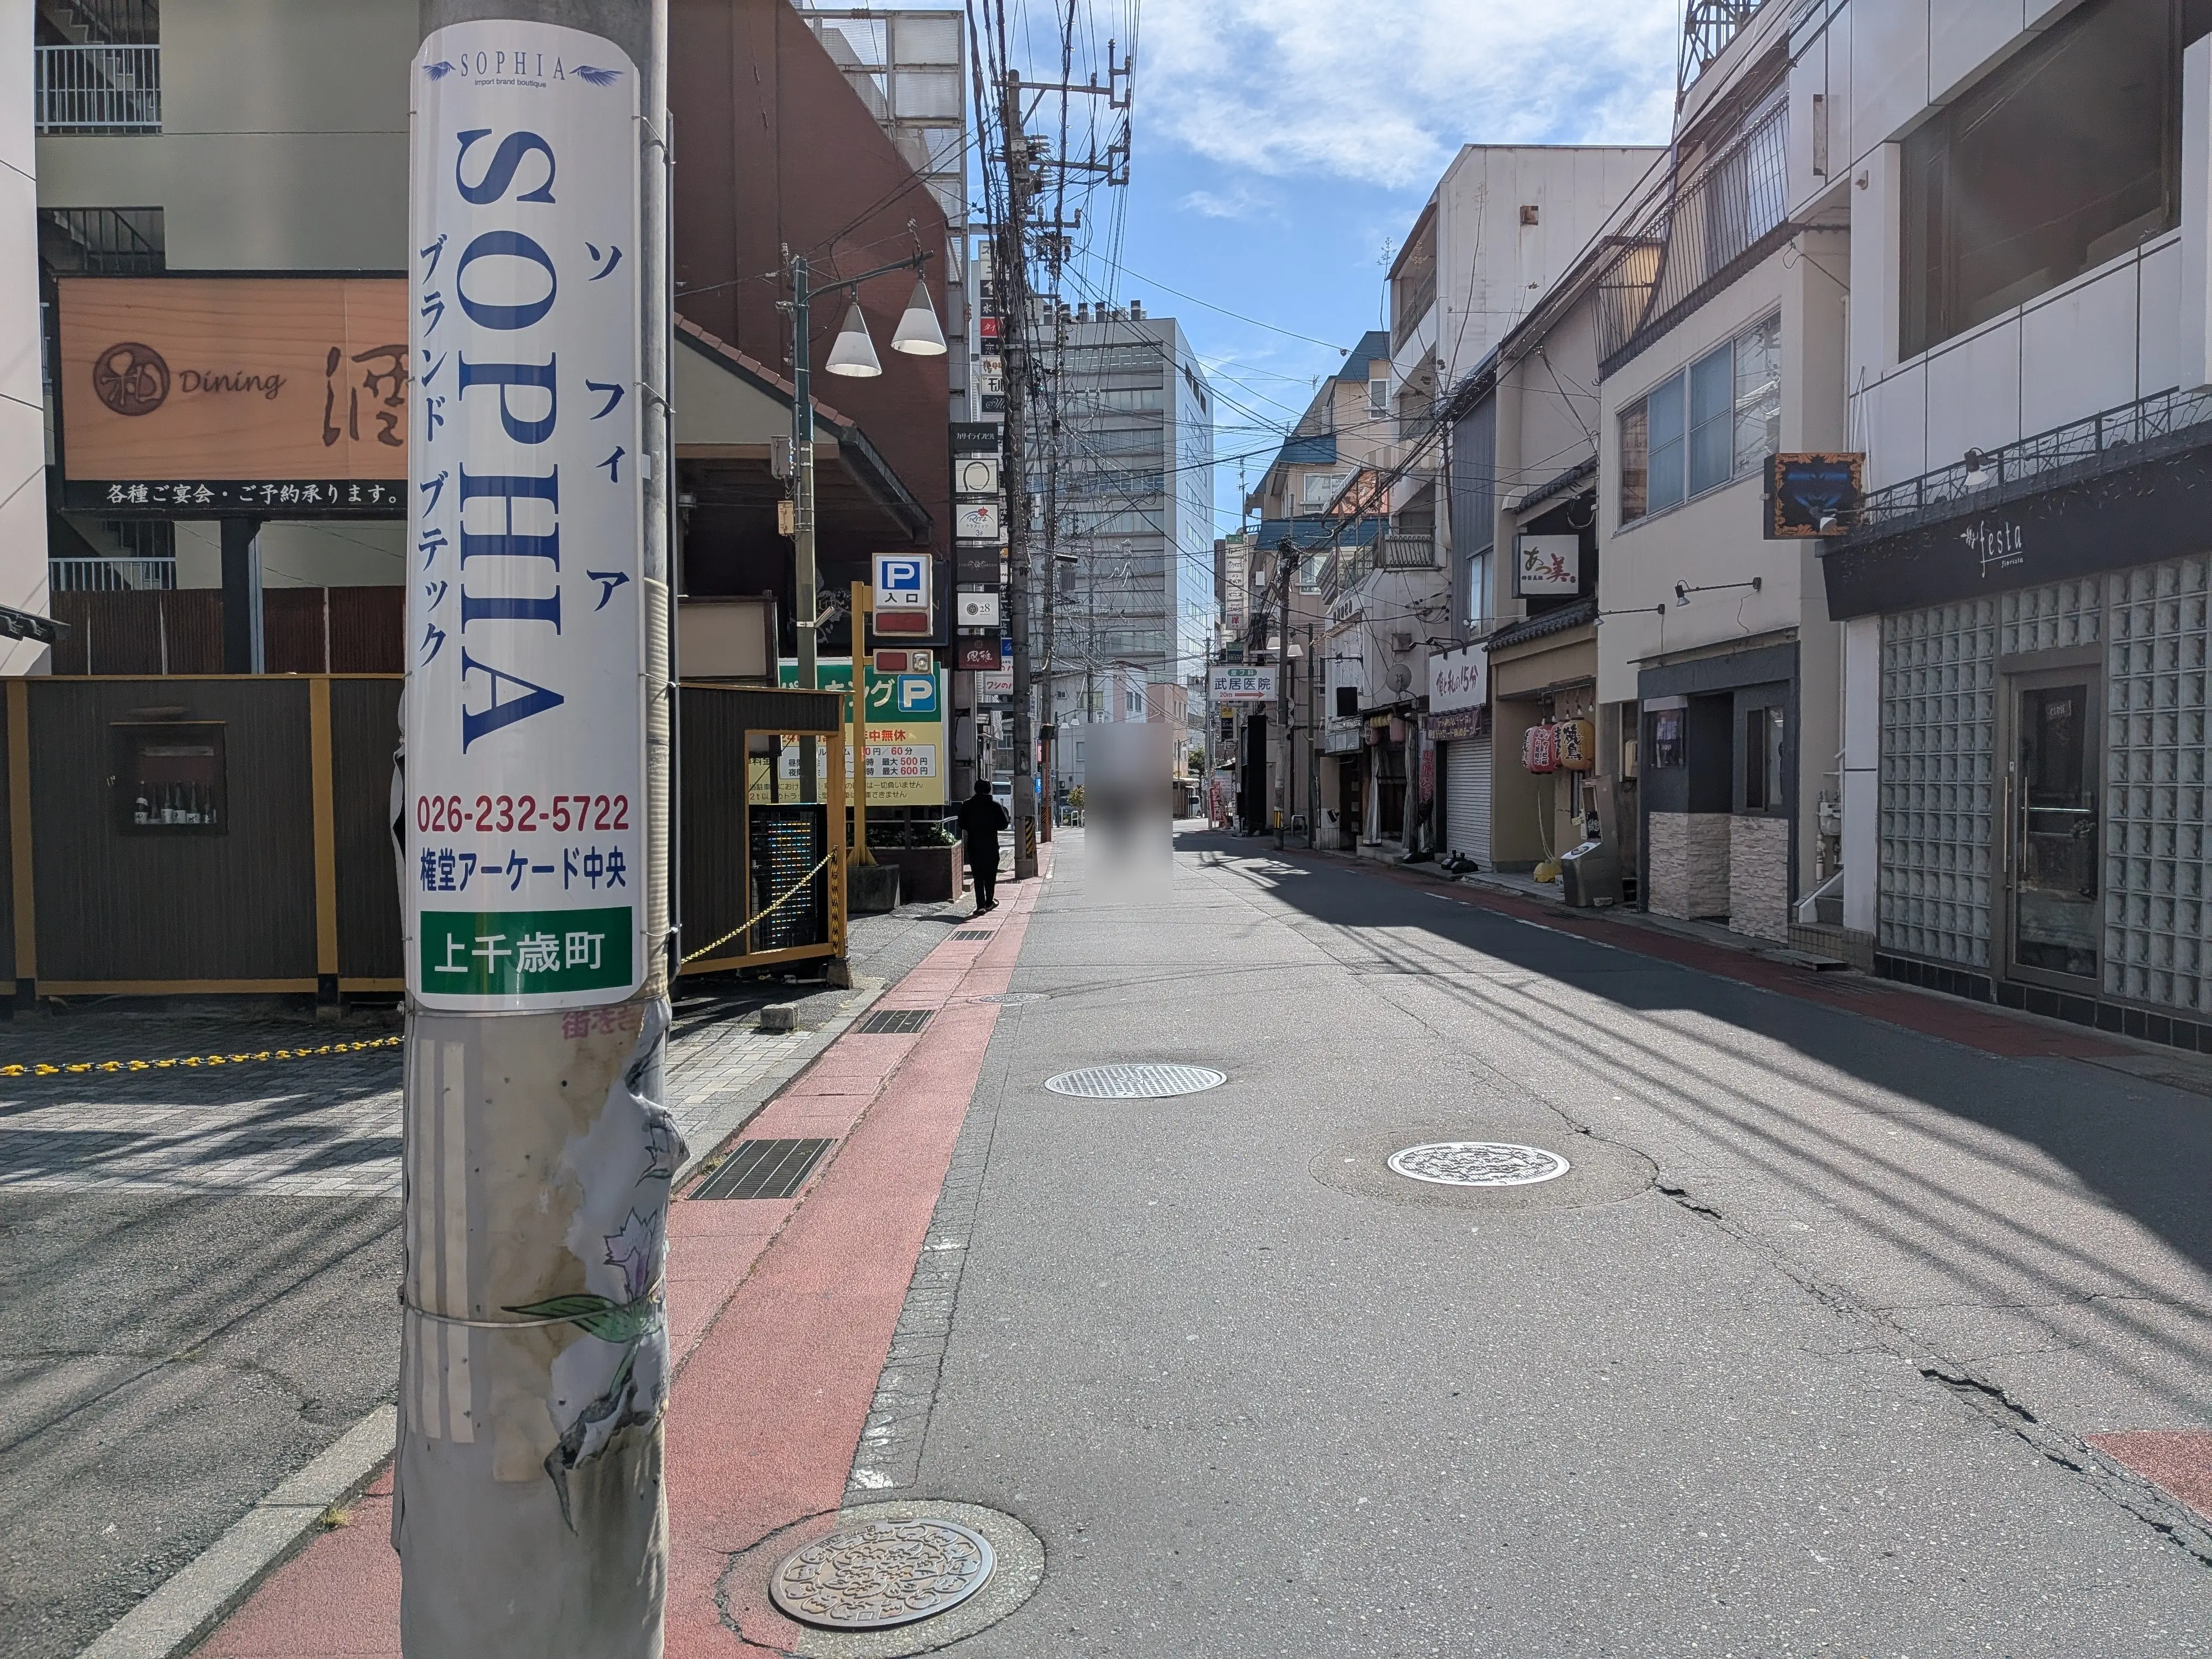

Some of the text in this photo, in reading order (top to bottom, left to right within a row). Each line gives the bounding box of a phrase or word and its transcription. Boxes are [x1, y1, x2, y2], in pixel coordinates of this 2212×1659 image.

[460, 50, 566, 81] SOPHIA
[495, 77, 515, 86] brand
[516, 79, 547, 88] boutique
[180, 369, 287, 400] Dining
[455, 128, 565, 755] SOPHIA
[585, 241, 630, 613] ソフィア
[418, 233, 449, 668] ブランド ブテック
[106, 483, 398, 505] 各種ご宴会・ご予約承ります。
[1980, 520, 2023, 578] festa
[887, 563, 915, 588] P
[884, 592, 919, 603] 入口
[979, 603, 991, 613] 28
[902, 680, 933, 708] P
[1214, 677, 1271, 691] 武居医院
[1436, 664, 1479, 697] 俺と私の15分
[417, 794, 629, 833] 026-232-5722
[420, 845, 627, 892] 権堂アーケード中央
[434, 931, 606, 974] 上千歳町
